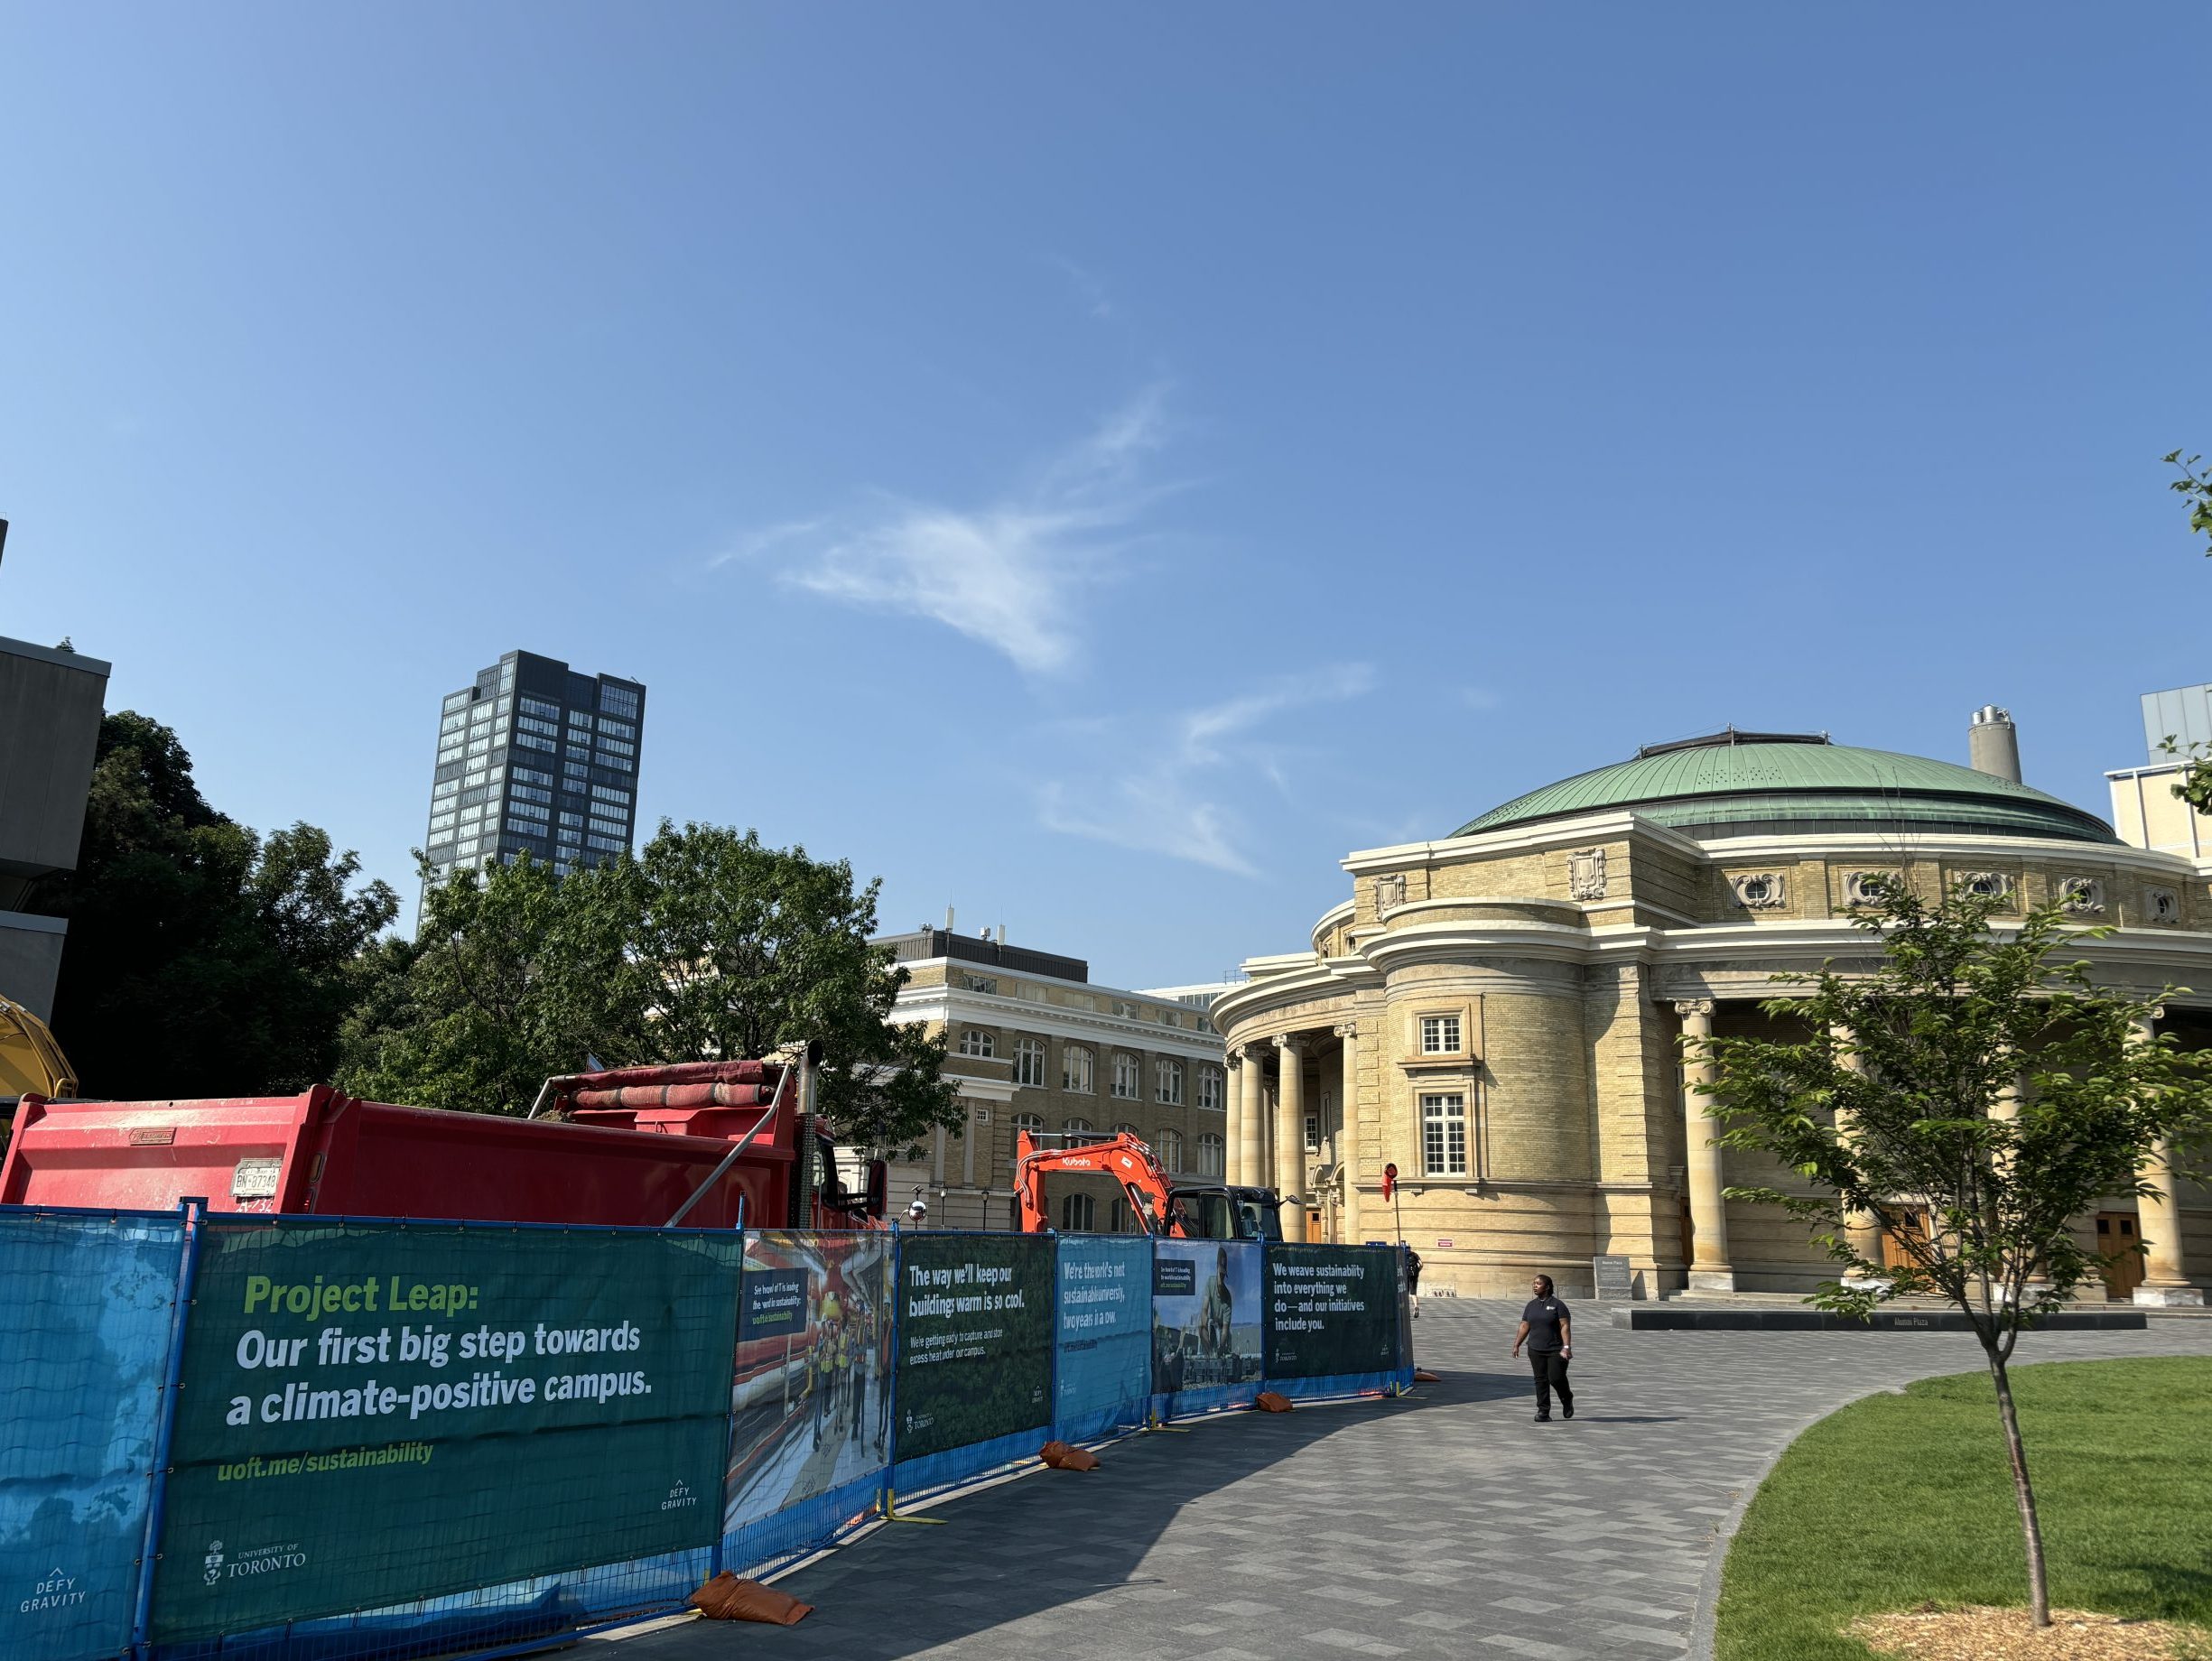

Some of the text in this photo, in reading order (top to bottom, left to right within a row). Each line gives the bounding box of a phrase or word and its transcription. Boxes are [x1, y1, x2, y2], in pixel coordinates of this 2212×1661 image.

[1062, 1156, 1092, 1166] Kubota
[909, 1264, 1011, 1289] The way we'll keep our
[1272, 1262, 1364, 1280] We weave sustainability
[1274, 1280, 1347, 1297] into everything we
[244, 1275, 479, 1321] Project Leap:
[909, 1293, 955, 1319] buildings
[956, 1295, 981, 1313] warm
[984, 1291, 992, 1311] is
[994, 1294, 1003, 1310] so
[1315, 1302, 1327, 1312] our
[1328, 1298, 1365, 1312] initiatives
[1104, 1311, 1117, 1324] ow.
[1275, 1317, 1324, 1333] include you.
[236, 1320, 640, 1369] Our first big step towards
[945, 1331, 958, 1344] eady
[226, 1370, 652, 1426] a climate-positive campus.
[218, 1442, 433, 1480] uoft.me/sustainability
[670, 1487, 690, 1498] DEFY
[661, 1497, 697, 1510] GRAVITY
[237, 1543, 299, 1560] UNIVERSITY OF
[227, 1553, 306, 1578] TORONTO
[36, 1577, 77, 1595] DEFY
[20, 1591, 87, 1613] GRAVITY
